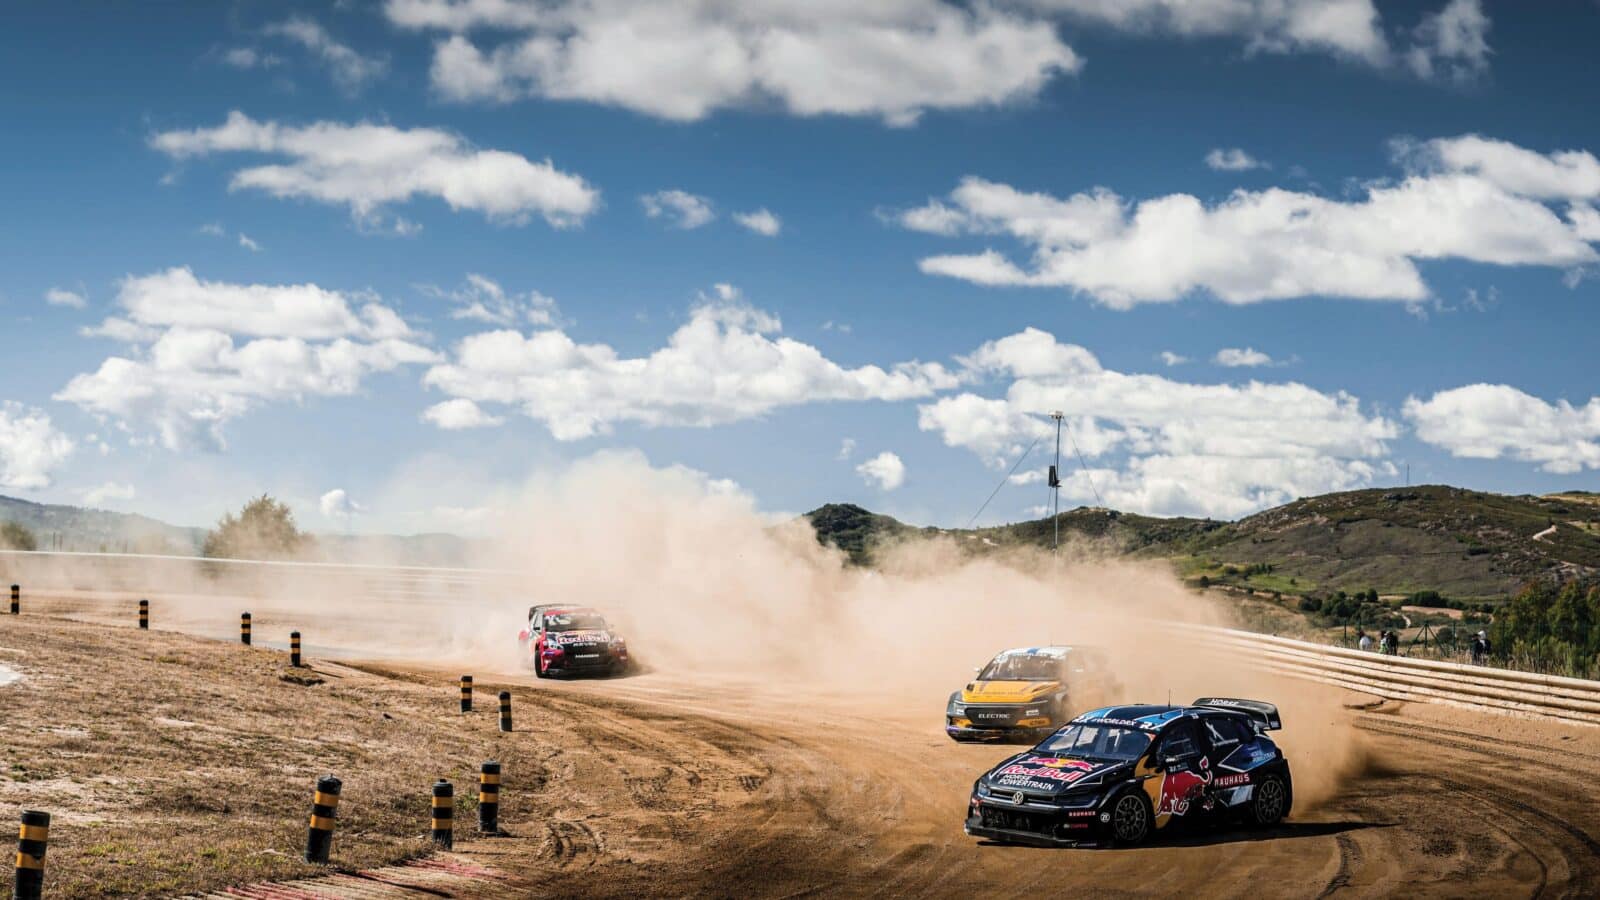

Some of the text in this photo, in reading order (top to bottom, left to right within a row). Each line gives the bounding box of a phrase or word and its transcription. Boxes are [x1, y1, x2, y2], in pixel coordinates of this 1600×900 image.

[1000, 764, 1086, 782] Red Bull
[998, 778, 1054, 789] POWERTRAIN
